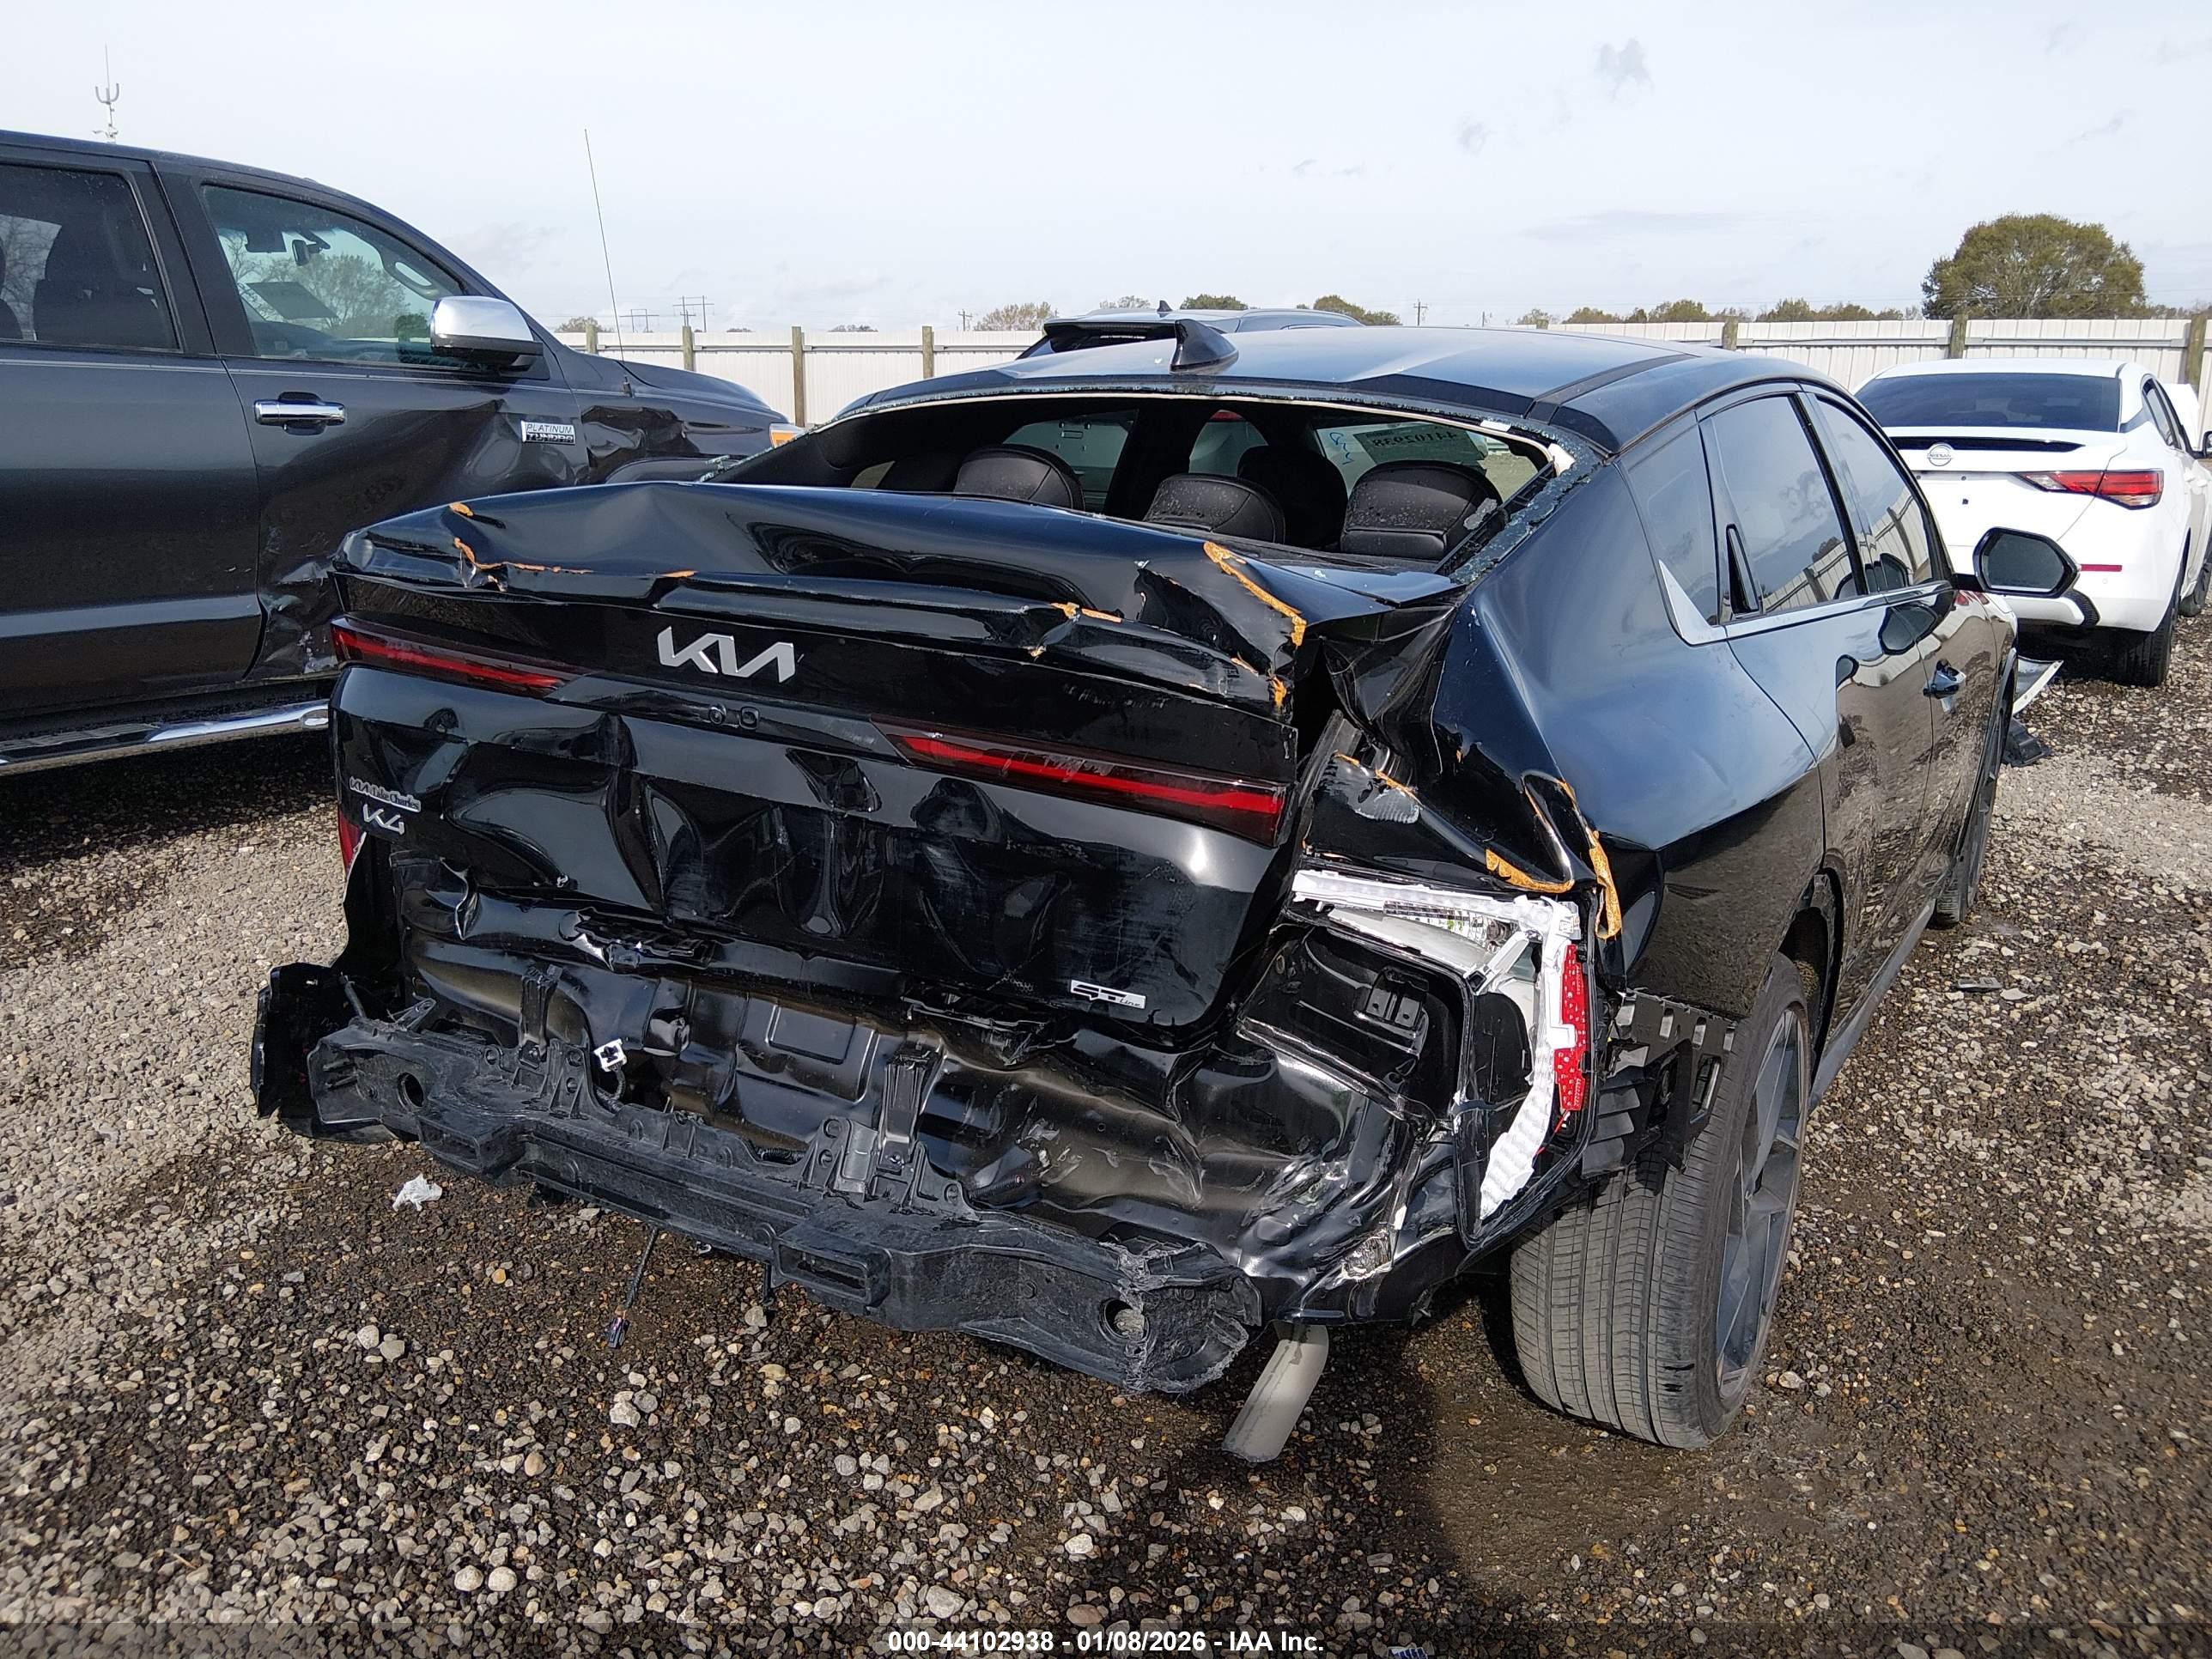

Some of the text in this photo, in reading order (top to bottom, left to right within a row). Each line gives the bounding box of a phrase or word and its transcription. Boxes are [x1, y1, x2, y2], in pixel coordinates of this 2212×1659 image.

[526, 423, 573, 434] PLATINUM
[526, 433, 574, 443] TUNDRA
[657, 626, 796, 684] KIA
[362, 804, 405, 836] K4
